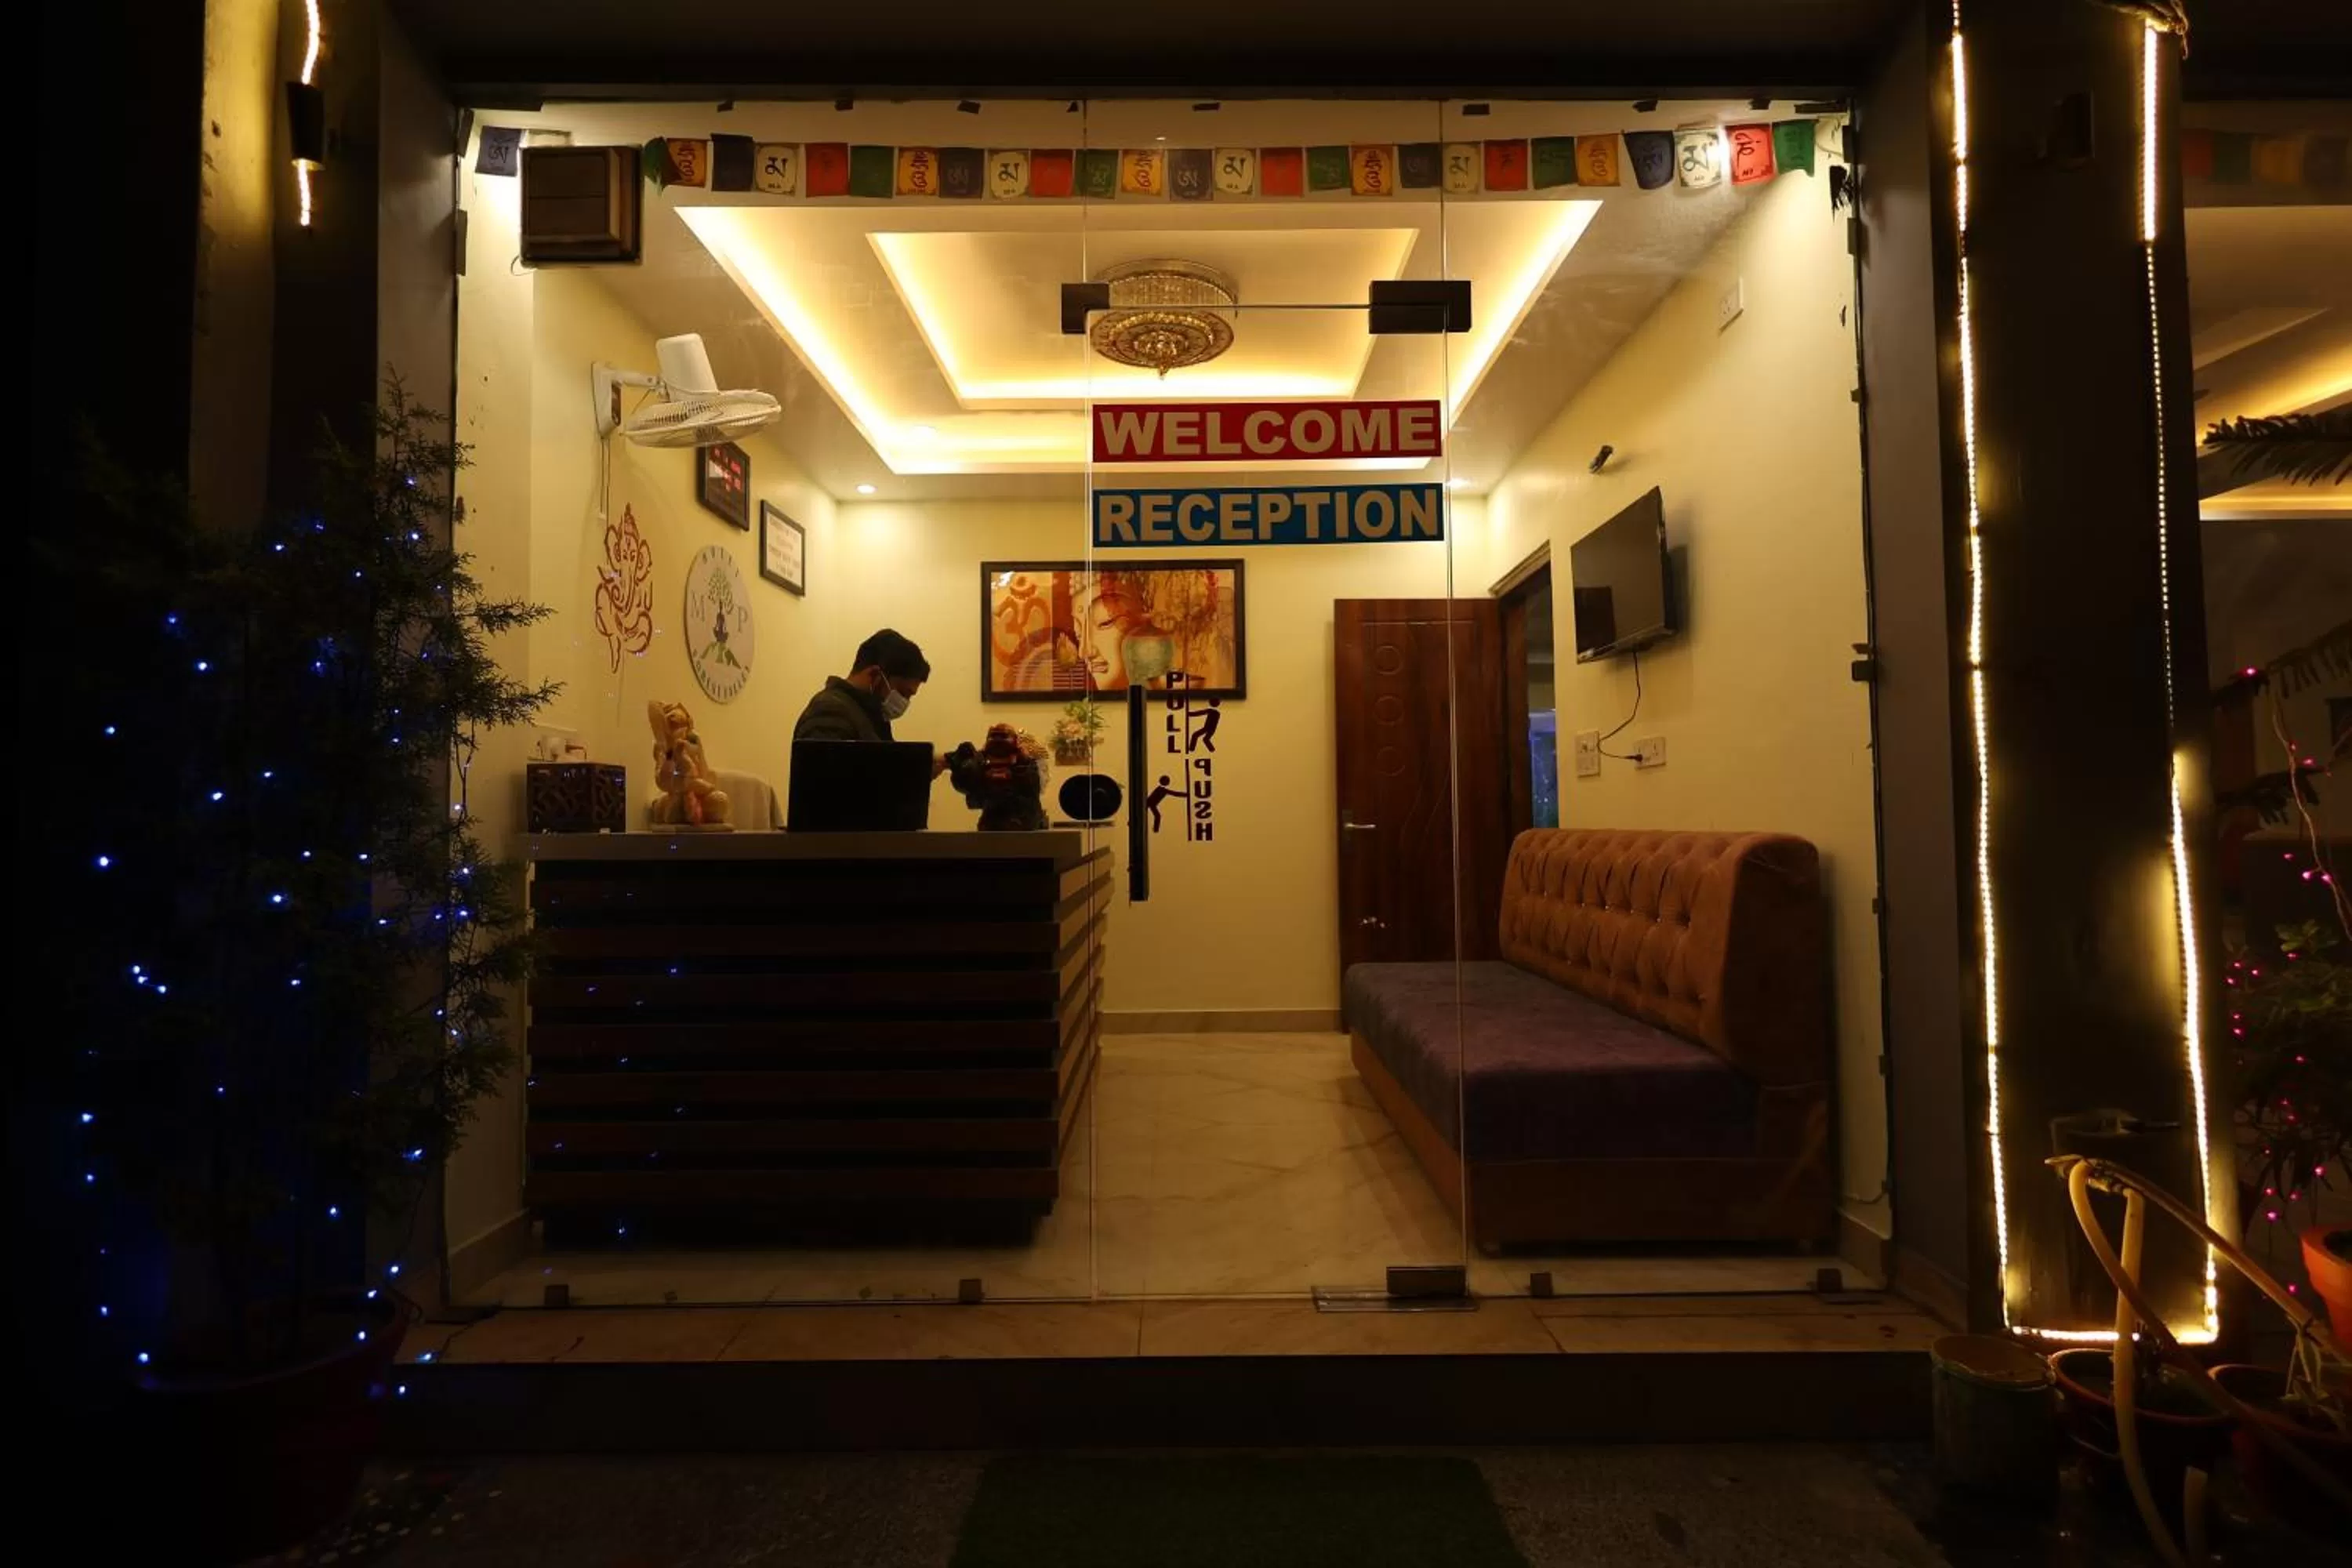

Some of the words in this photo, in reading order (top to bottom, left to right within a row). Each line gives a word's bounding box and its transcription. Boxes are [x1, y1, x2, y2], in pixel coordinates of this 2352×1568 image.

[1100, 407, 1436, 455] WELCOME
[1099, 488, 1438, 542] RECEPTION
[1167, 670, 1185, 753] PULL
